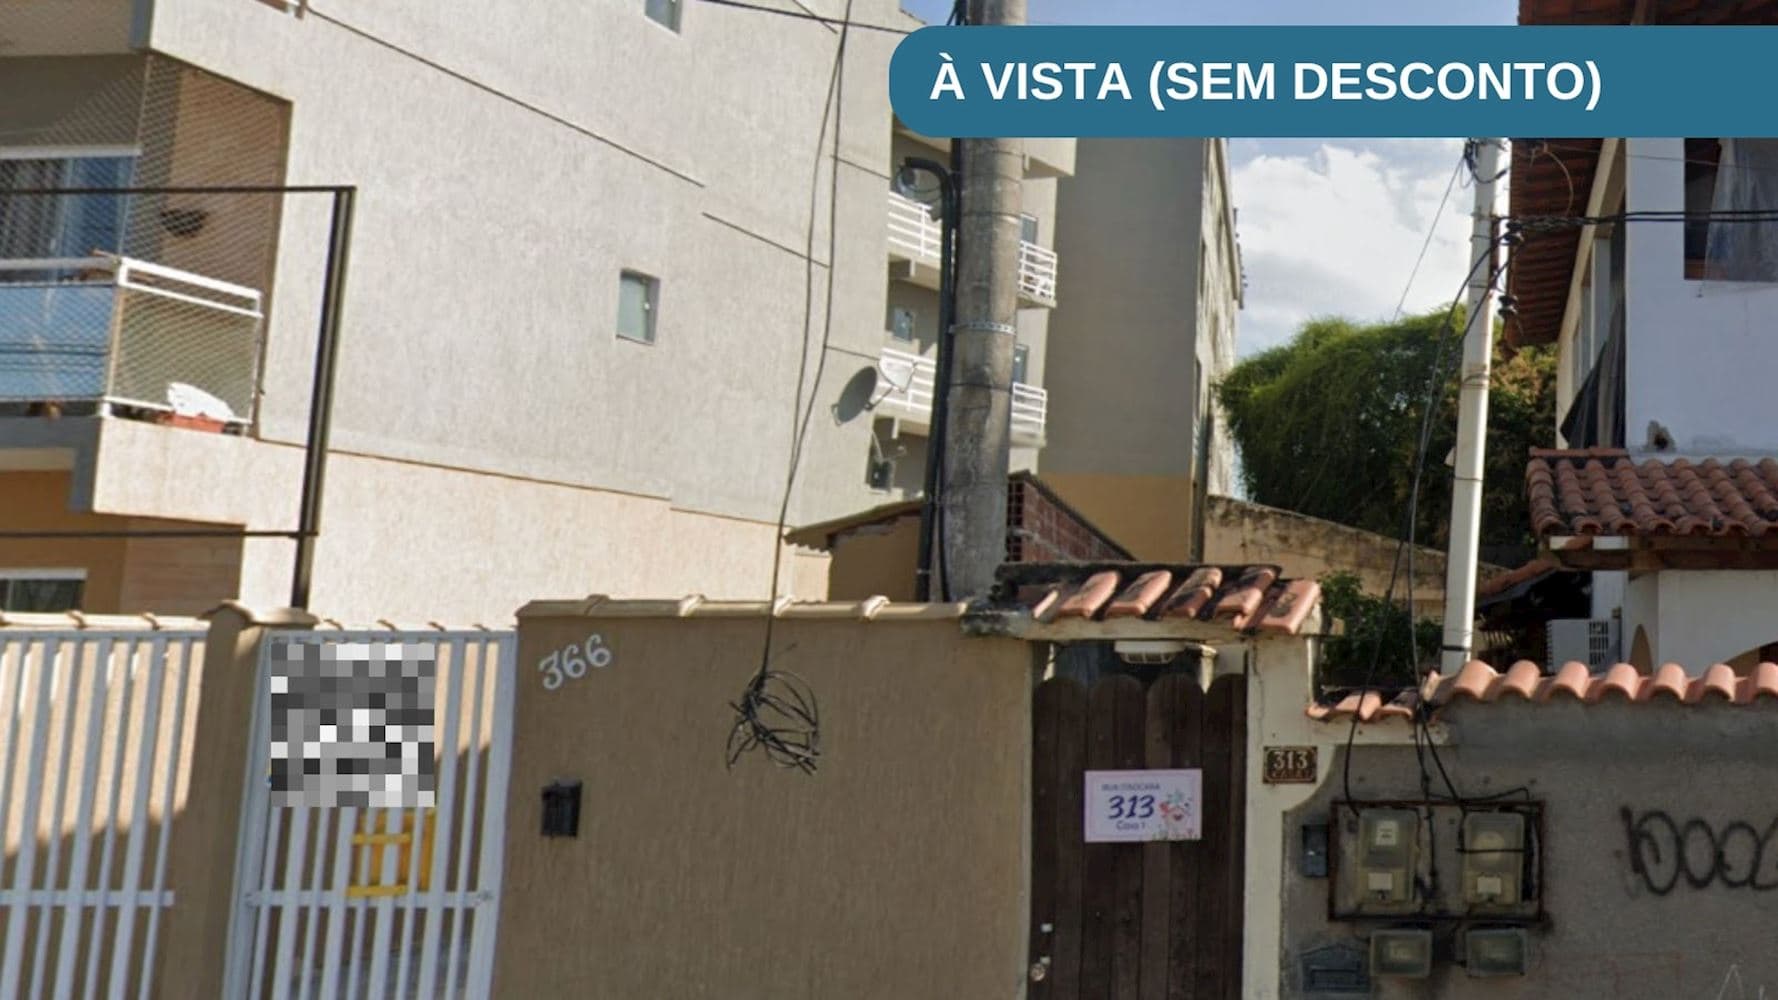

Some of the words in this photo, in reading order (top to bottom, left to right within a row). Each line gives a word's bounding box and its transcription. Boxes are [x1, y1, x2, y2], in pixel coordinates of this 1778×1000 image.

[538, 633, 612, 690] 366
[1273, 750, 1309, 769] 313
[1108, 795, 1155, 819] 313
